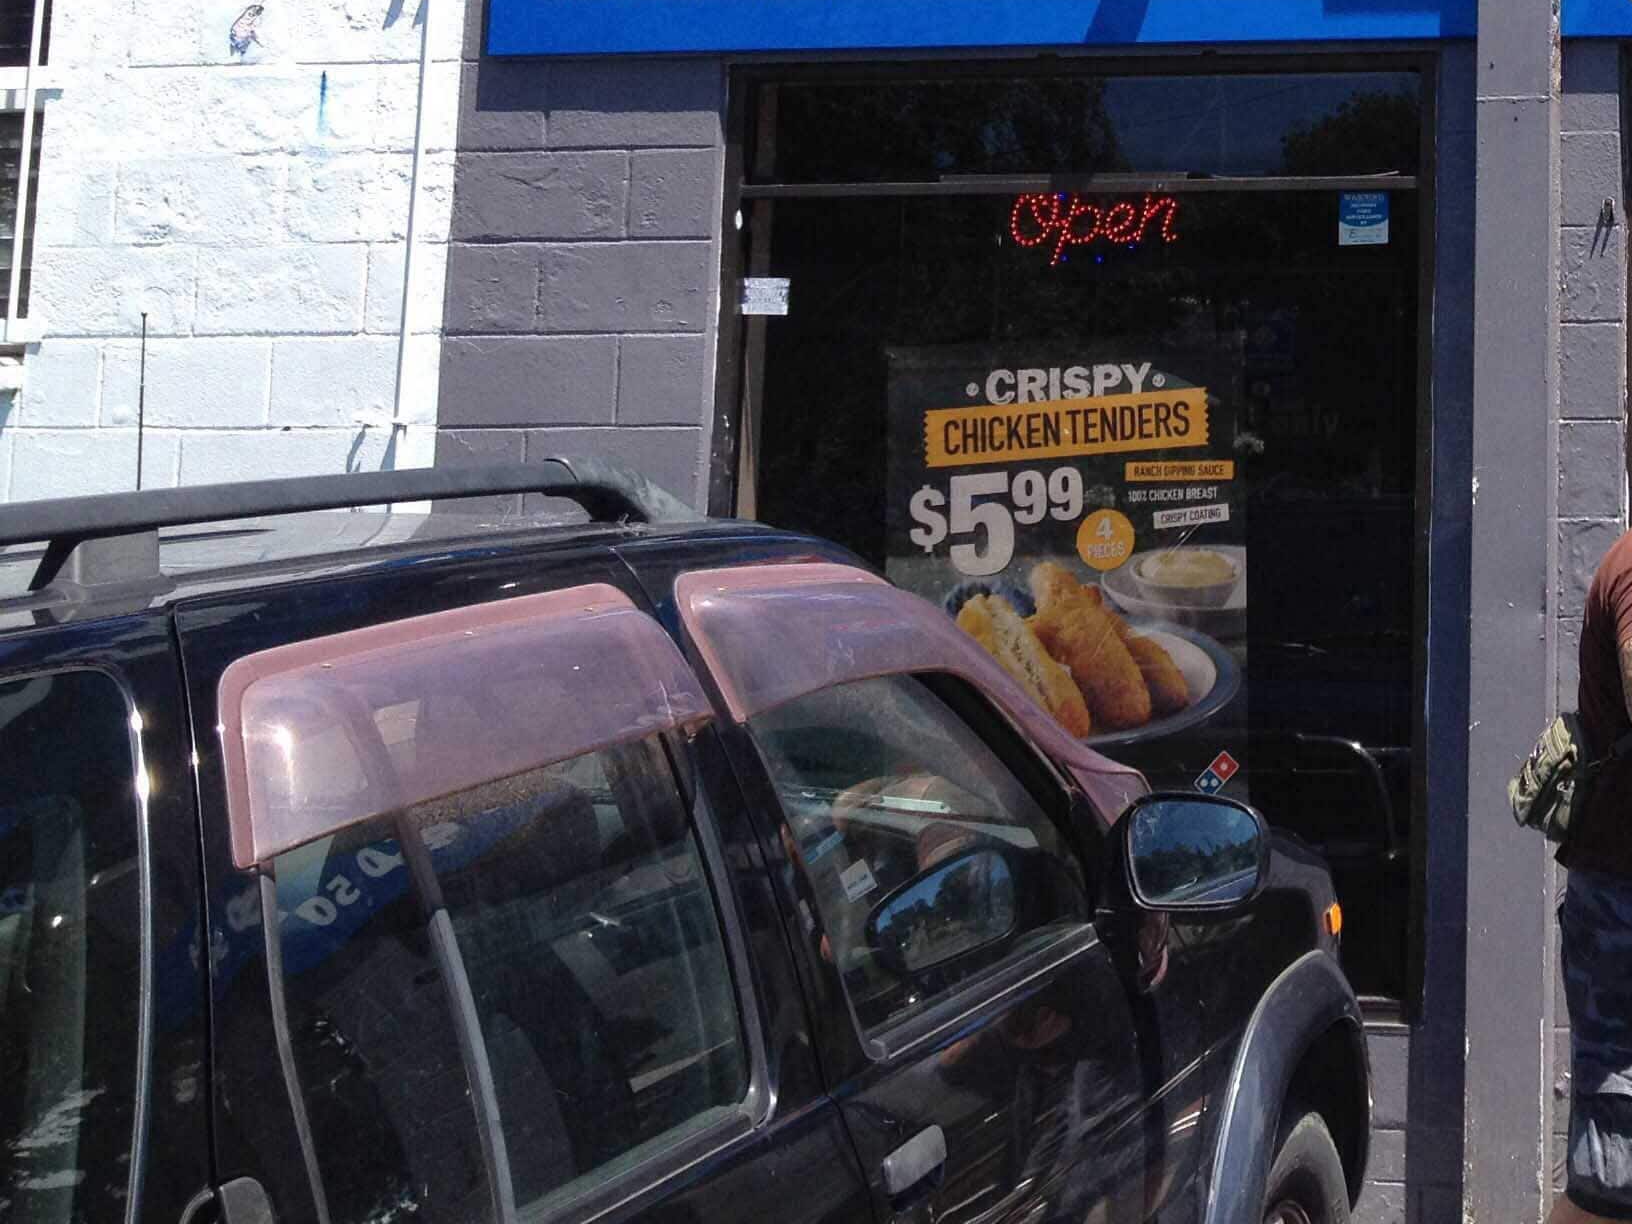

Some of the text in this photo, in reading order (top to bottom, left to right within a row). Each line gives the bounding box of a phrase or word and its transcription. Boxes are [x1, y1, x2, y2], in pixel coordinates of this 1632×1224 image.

[1010, 191, 1179, 267] Open
[984, 362, 1153, 405] CRISPY
[943, 400, 1191, 456] CHICKEN TENDERS
[1198, 464, 1225, 476] SAUCE
[1148, 487, 1184, 502] CHICKEN
[1186, 486, 1218, 500] BREAST
[1160, 508, 1222, 525] CRISPY COATING
[1095, 517, 1113, 540] 4
